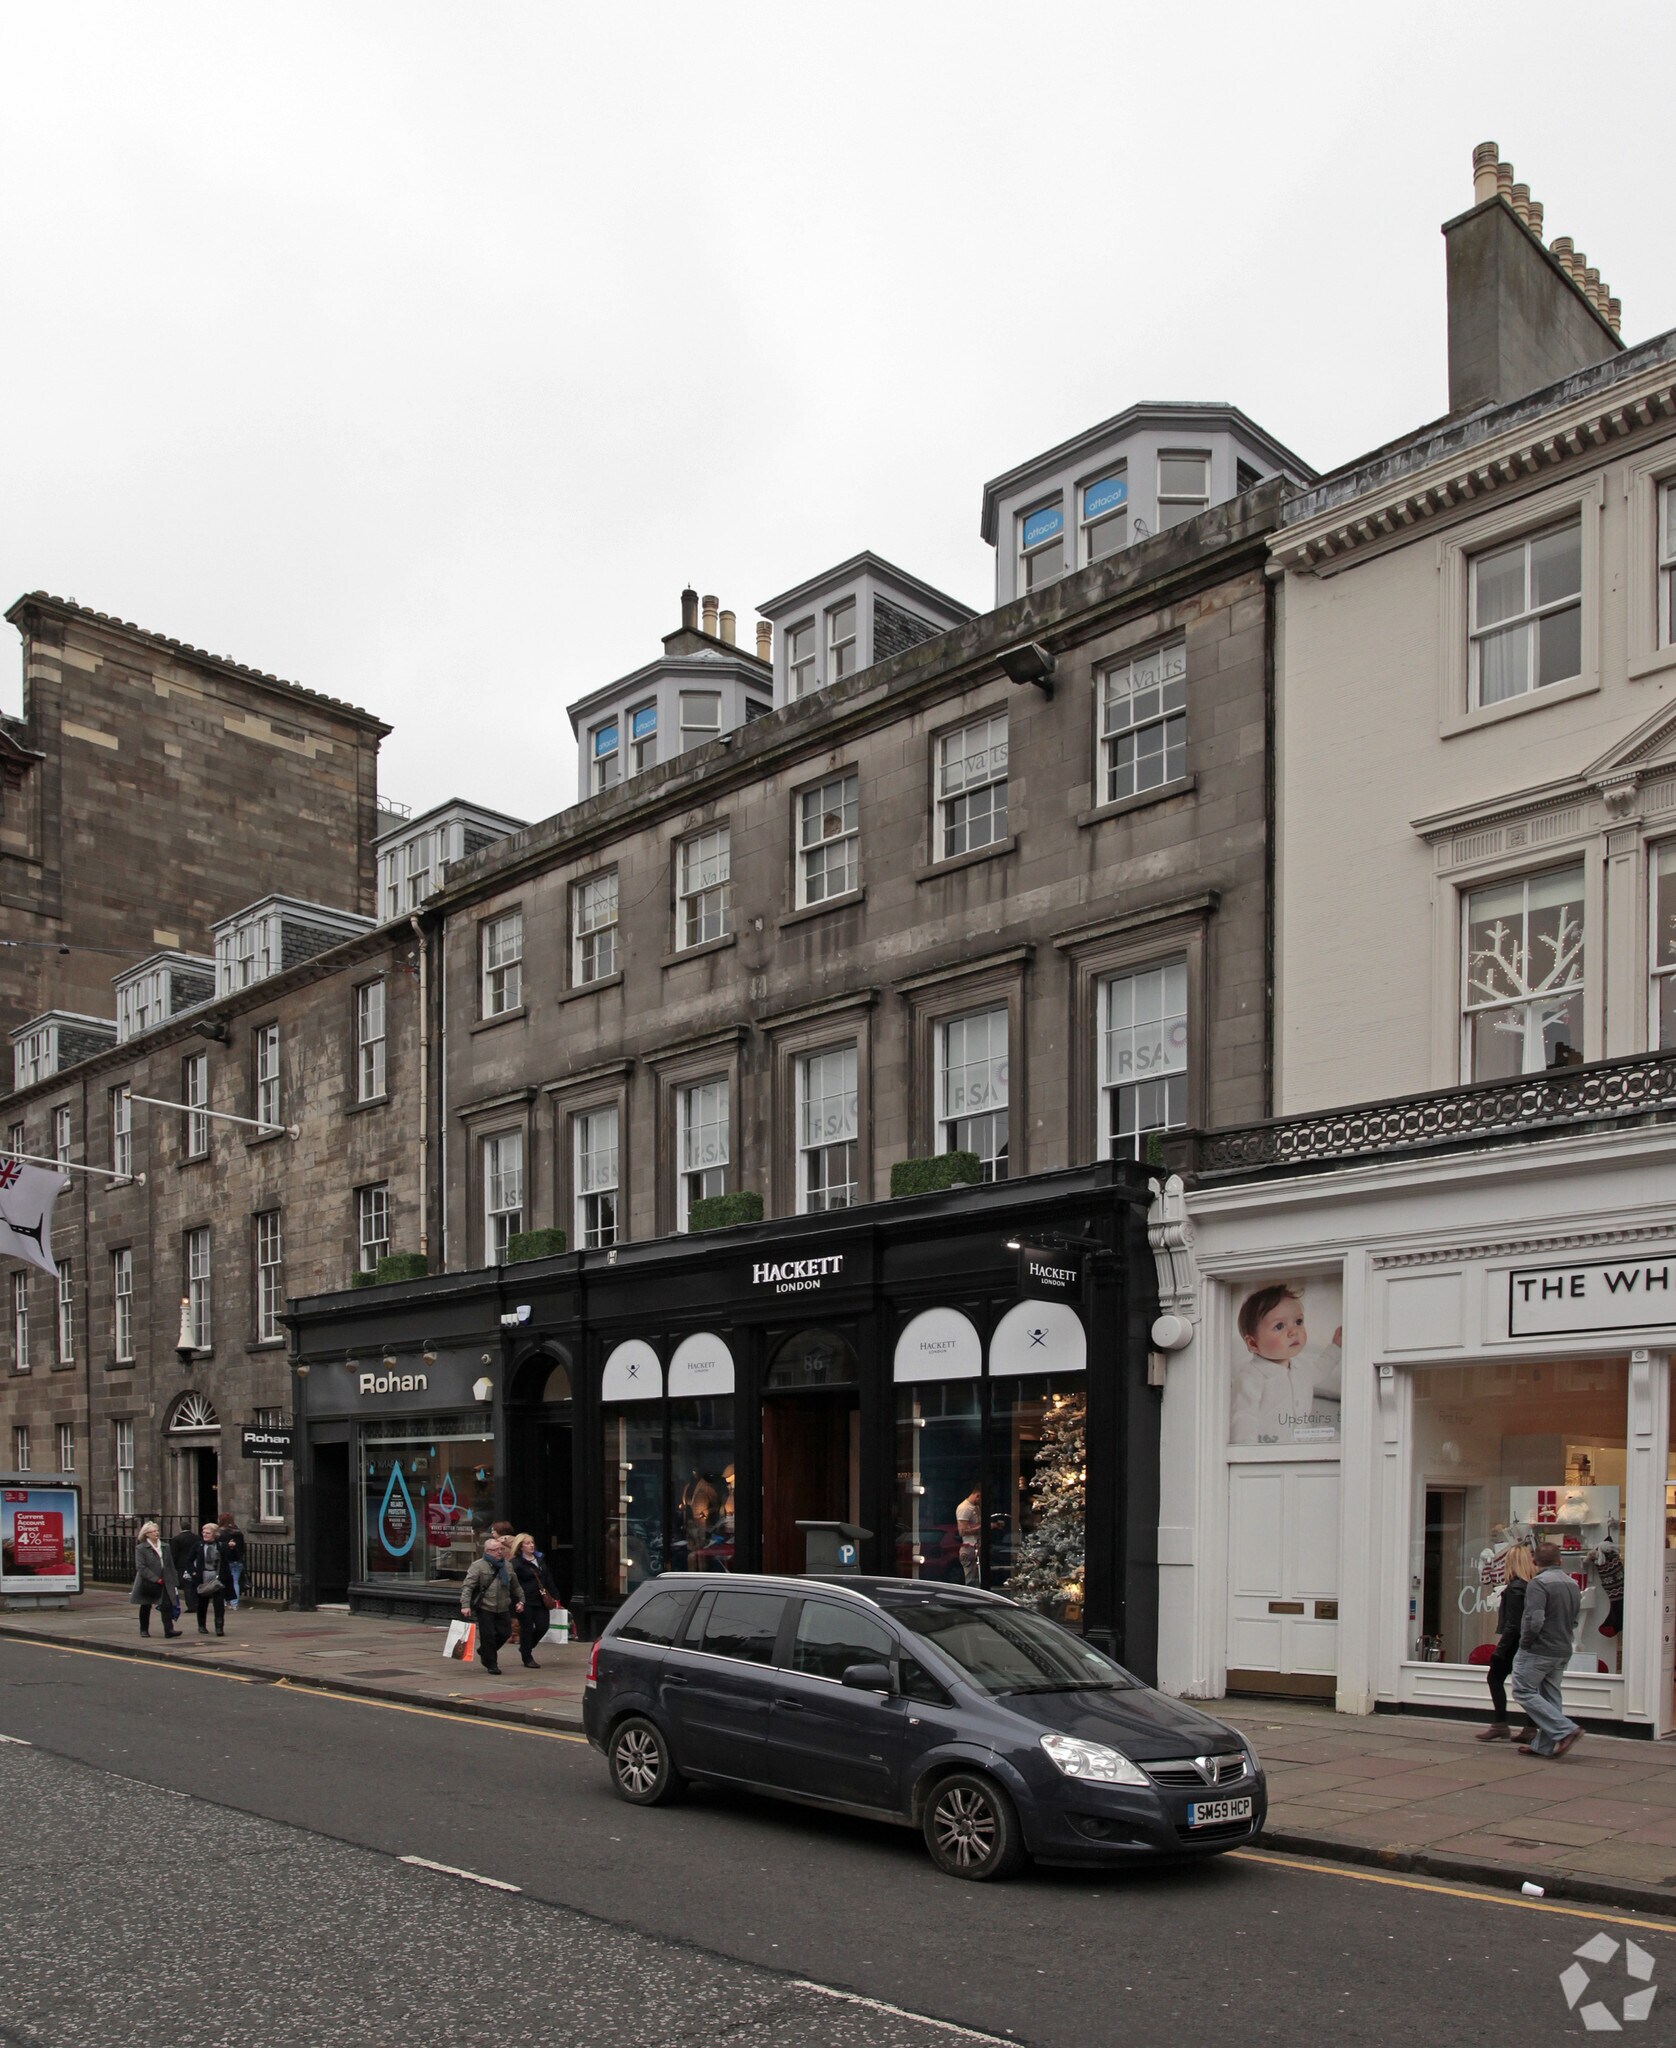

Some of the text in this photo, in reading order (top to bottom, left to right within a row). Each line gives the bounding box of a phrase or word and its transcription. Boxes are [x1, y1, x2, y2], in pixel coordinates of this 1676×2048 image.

[961, 746, 1008, 772] Wats
[1118, 1042, 1171, 1075] RSA
[954, 1082, 999, 1109] RSA
[814, 1113, 852, 1139] RSA
[752, 1254, 844, 1284] HACKETT
[1029, 1262, 1078, 1282] HACKETT
[776, 1279, 821, 1294] LONDON
[1041, 1278, 1066, 1288] LONDON
[1517, 1274, 1586, 1302] THE
[920, 1340, 957, 1350] HACKETT
[687, 1361, 716, 1370] HACKETT
[803, 1354, 824, 1372] 86
[359, 1371, 428, 1395] Rohan
[1277, 1410, 1333, 1428] Upstairs
[244, 1432, 291, 1445] Rohan
[17, 1532, 42, 1545] 4%
[840, 1544, 855, 1564] P
[1457, 1585, 1500, 1615] Ch
[1197, 1799, 1250, 1820] SM59 HCP
